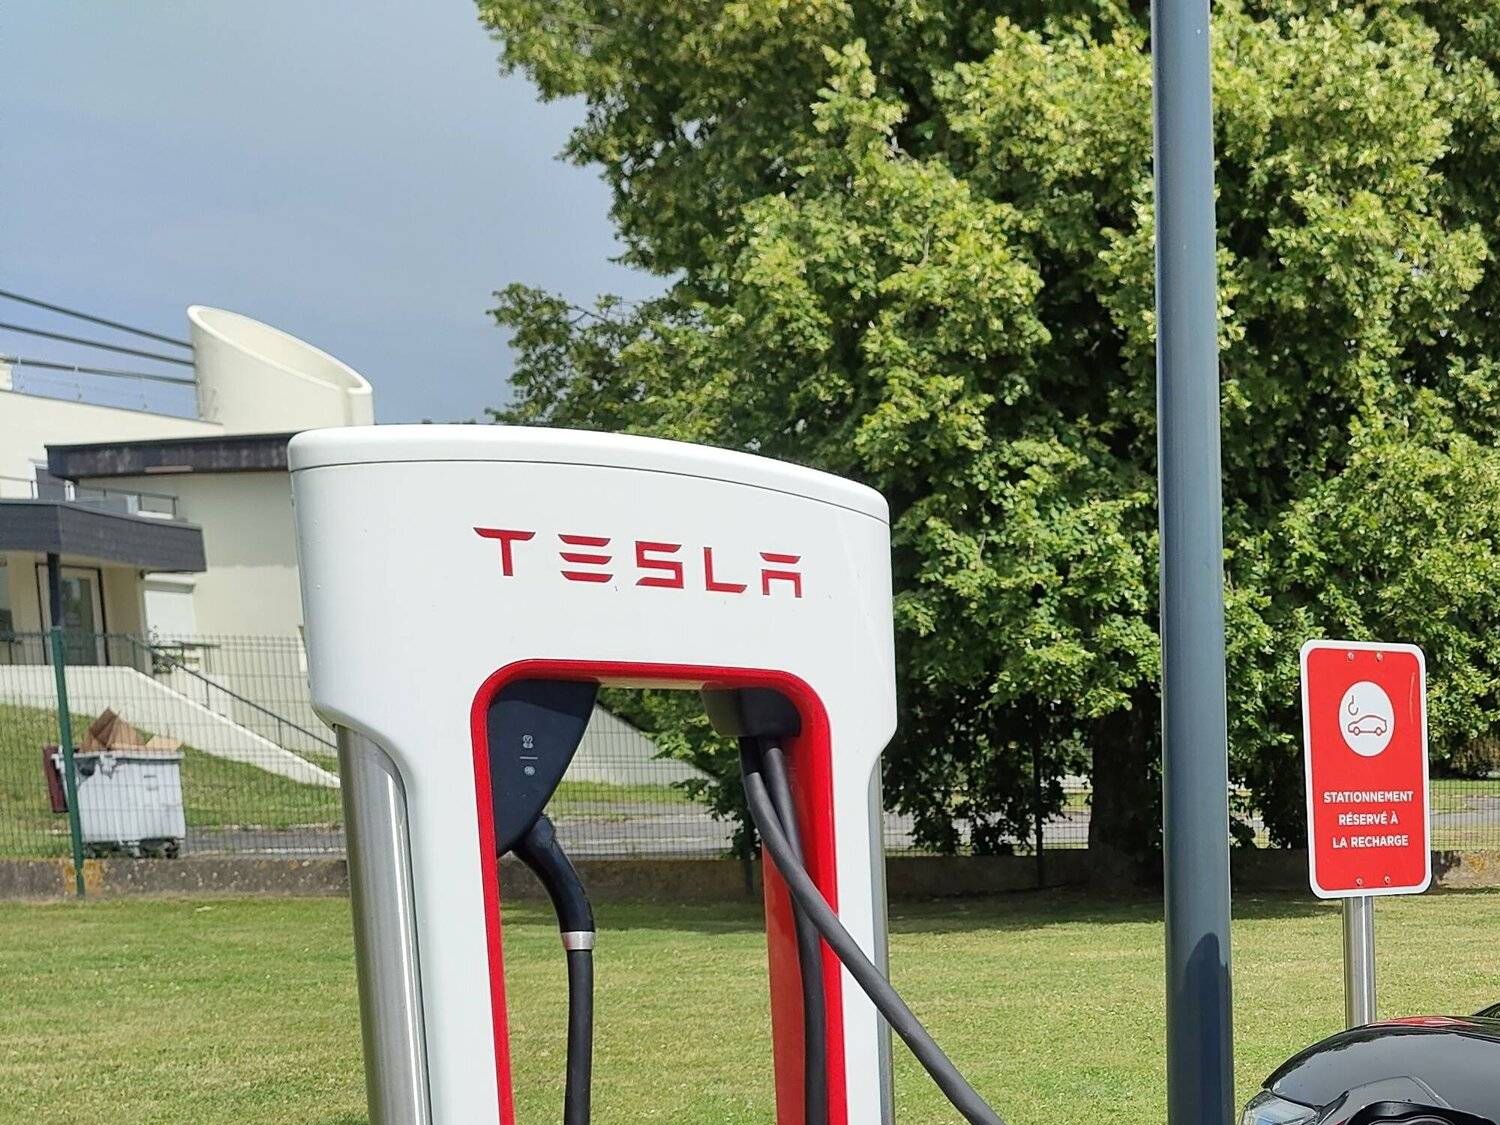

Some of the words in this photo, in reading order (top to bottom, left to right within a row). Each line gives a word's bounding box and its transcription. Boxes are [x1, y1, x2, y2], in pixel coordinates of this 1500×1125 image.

[473, 526, 802, 599] TESLA
[1323, 790, 1414, 803] STATIONNEMENT
[1338, 811, 1388, 826] RÉSERVÉ
[1390, 811, 1399, 825] À
[1332, 836, 1348, 849] LA
[1350, 834, 1409, 848] RECHARGE
